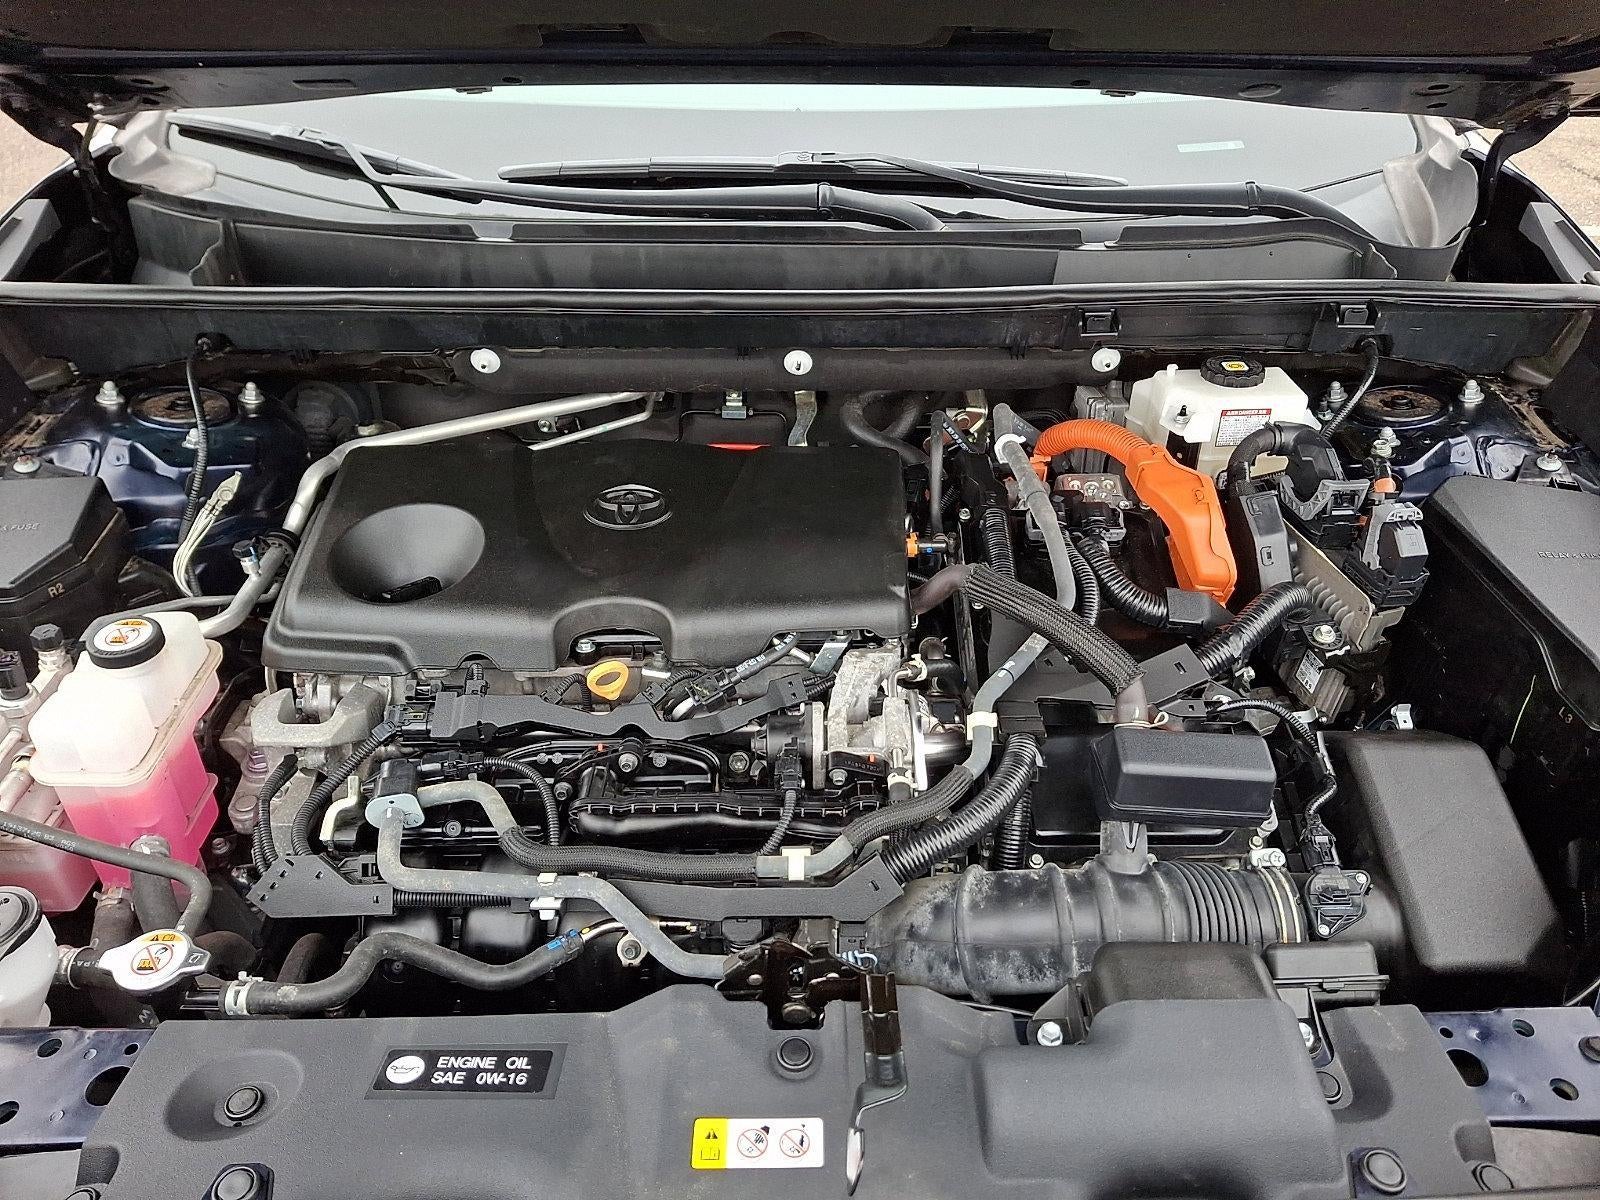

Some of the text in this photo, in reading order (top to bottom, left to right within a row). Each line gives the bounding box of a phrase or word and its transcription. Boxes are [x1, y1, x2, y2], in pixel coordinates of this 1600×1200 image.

[1537, 551, 1570, 559] RELAY
[47, 583, 66, 598] R2
[1558, 706, 1573, 724] L3
[436, 1056, 532, 1070] ENGINE OIL
[430, 1071, 528, 1086] SAE 0W-16
